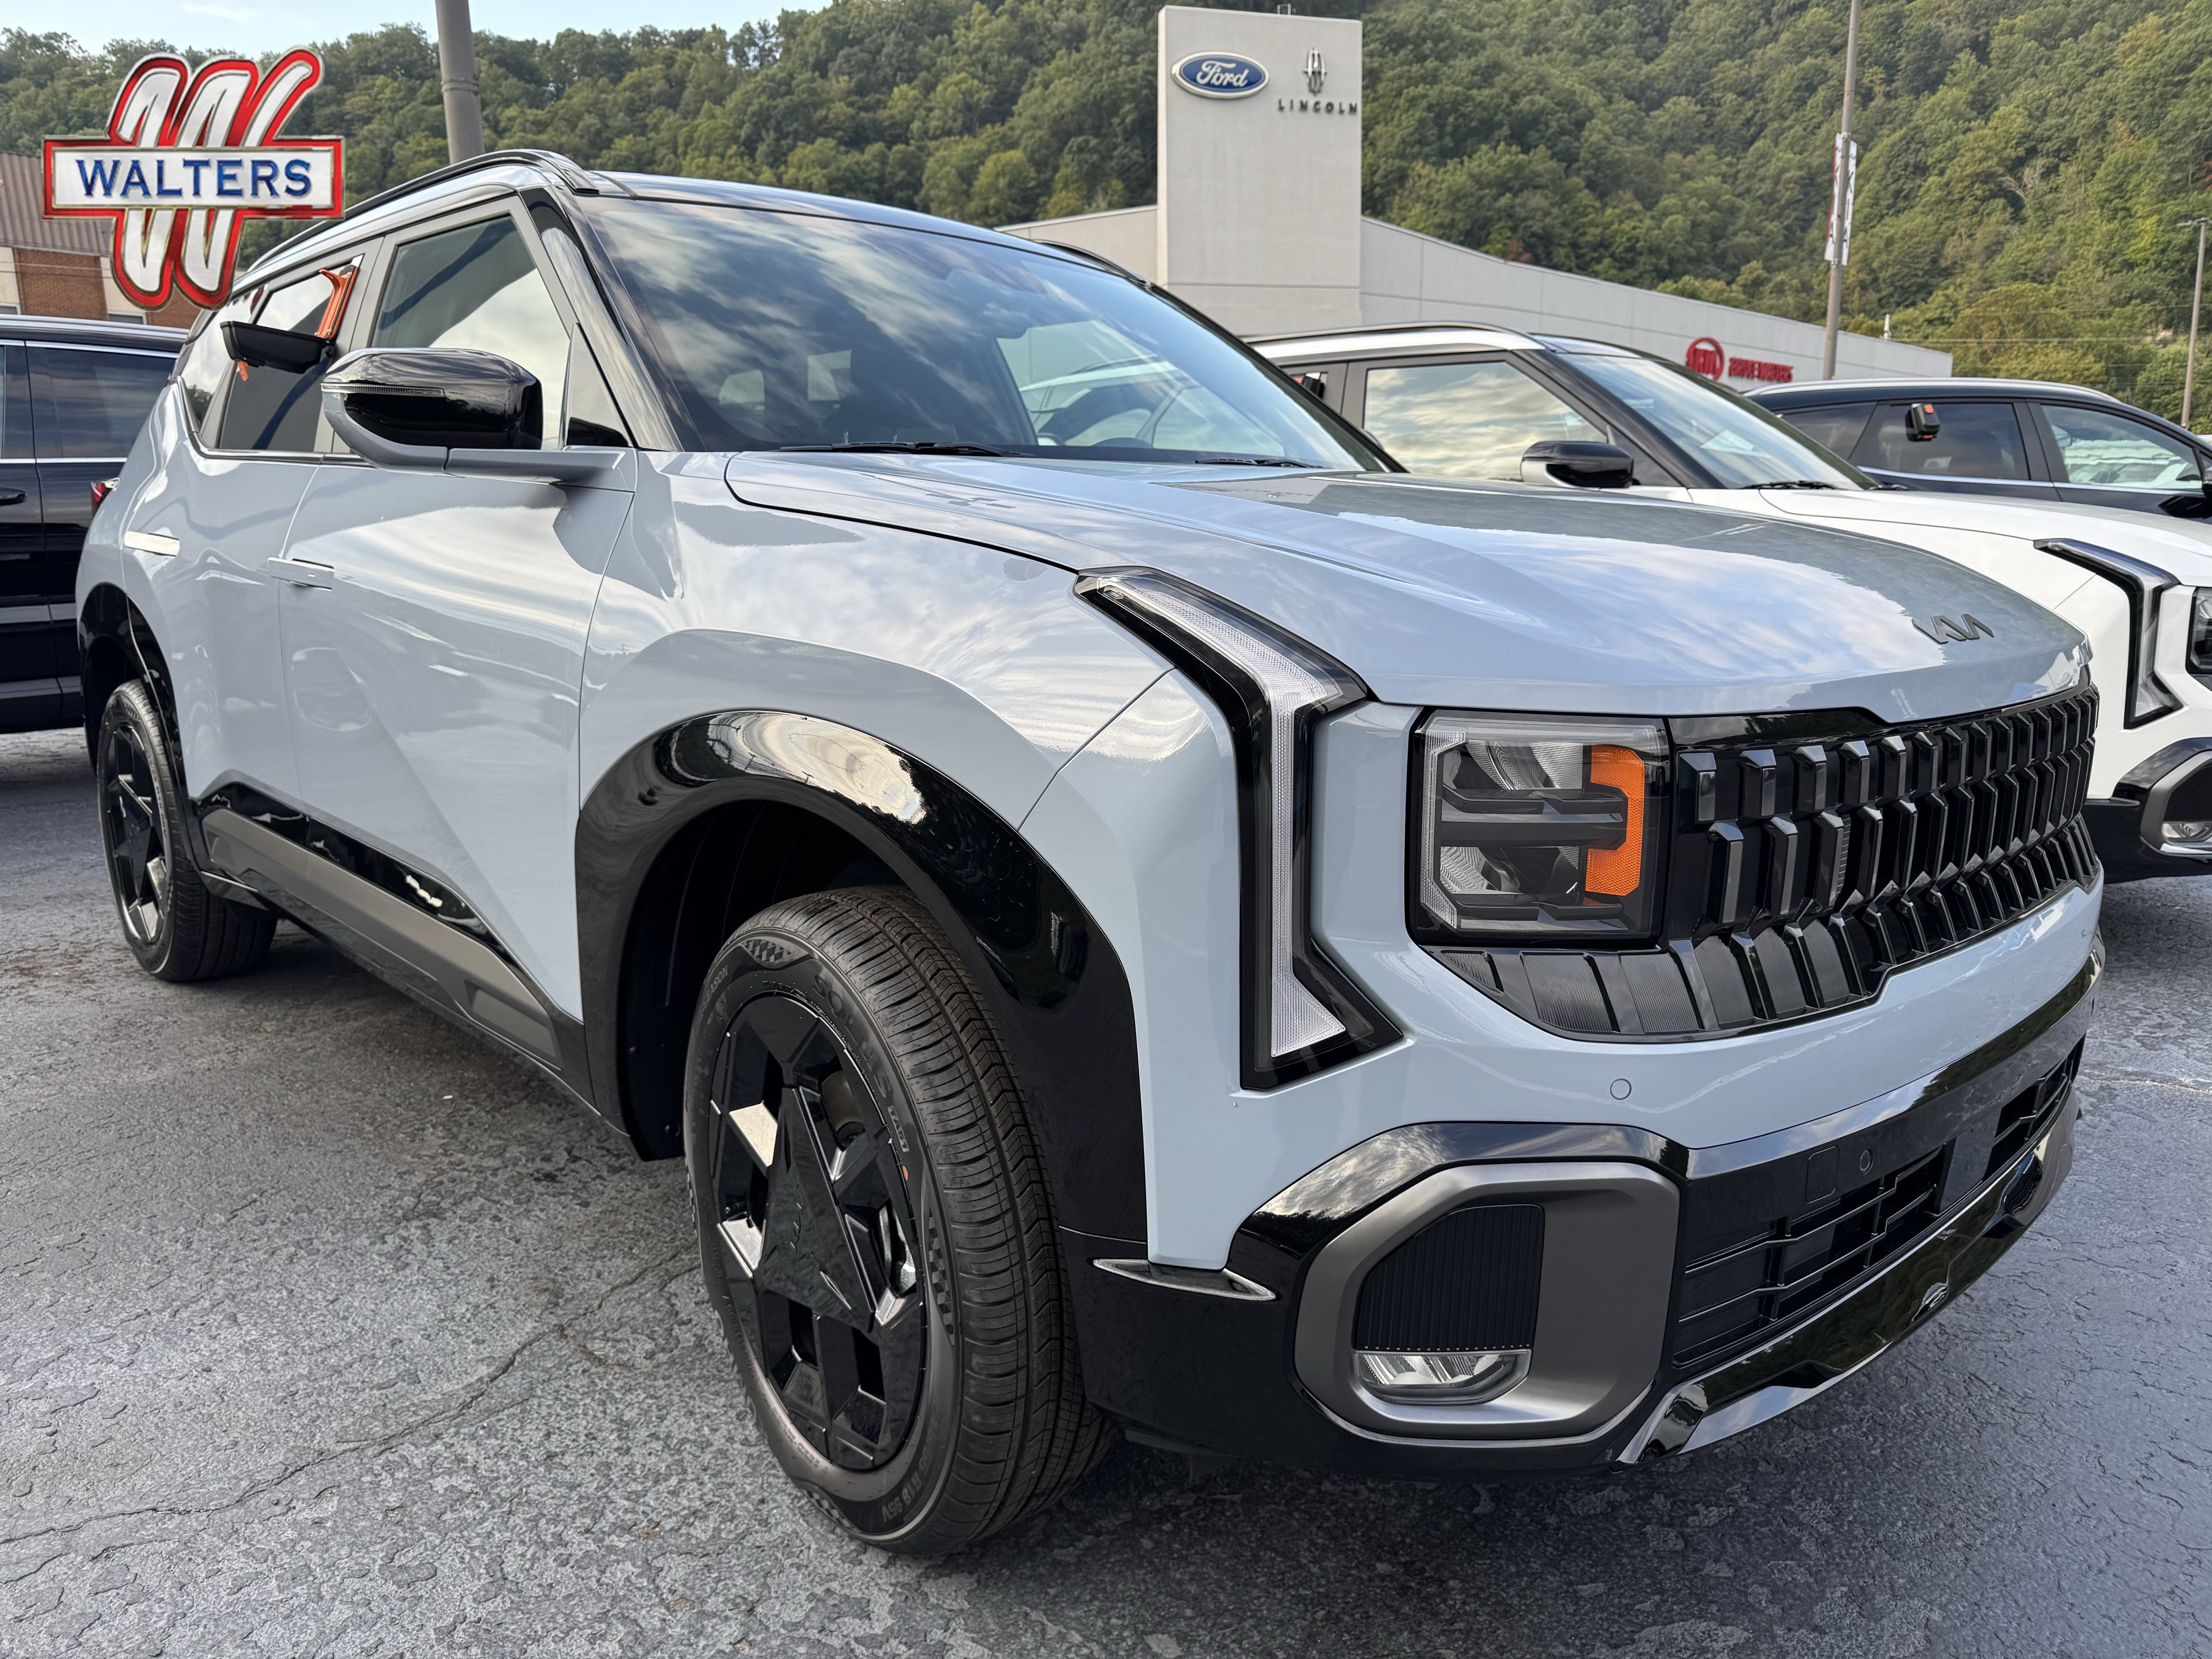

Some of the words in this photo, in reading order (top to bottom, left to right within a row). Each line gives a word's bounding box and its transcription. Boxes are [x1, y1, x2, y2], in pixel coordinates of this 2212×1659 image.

[1197, 60, 1249, 88] Ford
[1278, 98, 1358, 115] LINCOLN
[1911, 613, 1994, 645] KIA
[812, 974, 891, 1098] SOLUS
